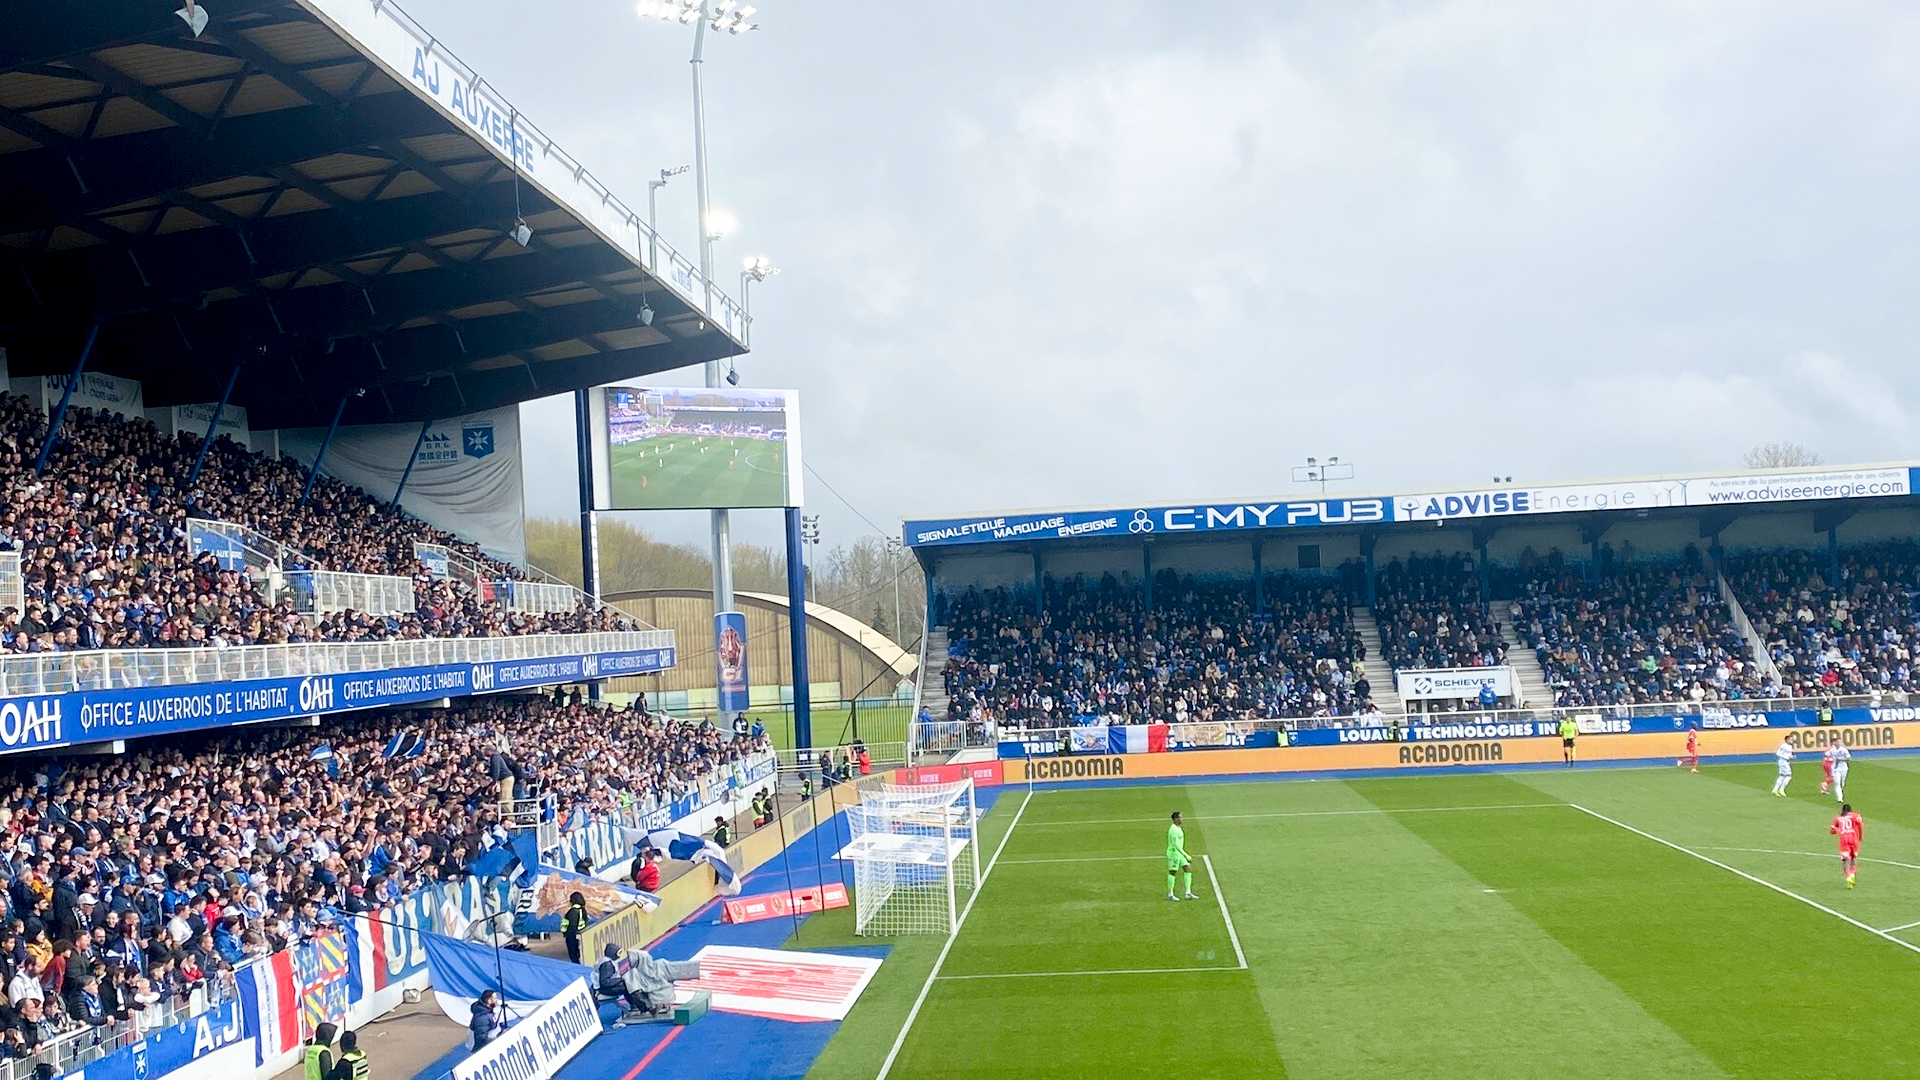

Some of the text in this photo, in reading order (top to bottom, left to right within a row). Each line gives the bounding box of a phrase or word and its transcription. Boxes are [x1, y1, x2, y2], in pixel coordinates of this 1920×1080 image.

[412, 46, 534, 173] AJ AUXERRE
[1768, 475, 1813, 485] performance
[1815, 473, 1852, 481] industrielle
[1854, 472, 1864, 480] de
[1709, 481, 1904, 500] www.adviseenergie.com
[1424, 490, 1636, 517] ADVISE Energie
[1164, 500, 1384, 530] C-MY PUB
[917, 518, 1006, 543] SIGNALETIQUE
[993, 517, 1065, 539] MARQUAGE
[1057, 518, 1118, 537] ENSEIGNE
[582, 656, 598, 677] OAH
[659, 650, 671, 667] OAH
[472, 664, 494, 691] OAH
[500, 661, 579, 683] OFFICE AUXERROIS DE L'HABITAT
[1435, 678, 1496, 687] SCHIEVER
[300, 678, 333, 712] OAH
[344, 671, 466, 700] OFFICE AUXERROIS DE L'HABITAT
[80, 687, 289, 731] OFFICE AUXERROIS DE L'HABITAT
[0, 699, 62, 746] OAH
[1414, 722, 1533, 740] TECHNOLOGIES
[1790, 726, 1895, 748] ACADOMIA
[1400, 742, 1503, 764] ACADOMIA
[1025, 757, 1124, 779] ACADOMIA
[593, 910, 642, 960] ACADOMIA
[536, 992, 596, 1063] ACADOMIA
